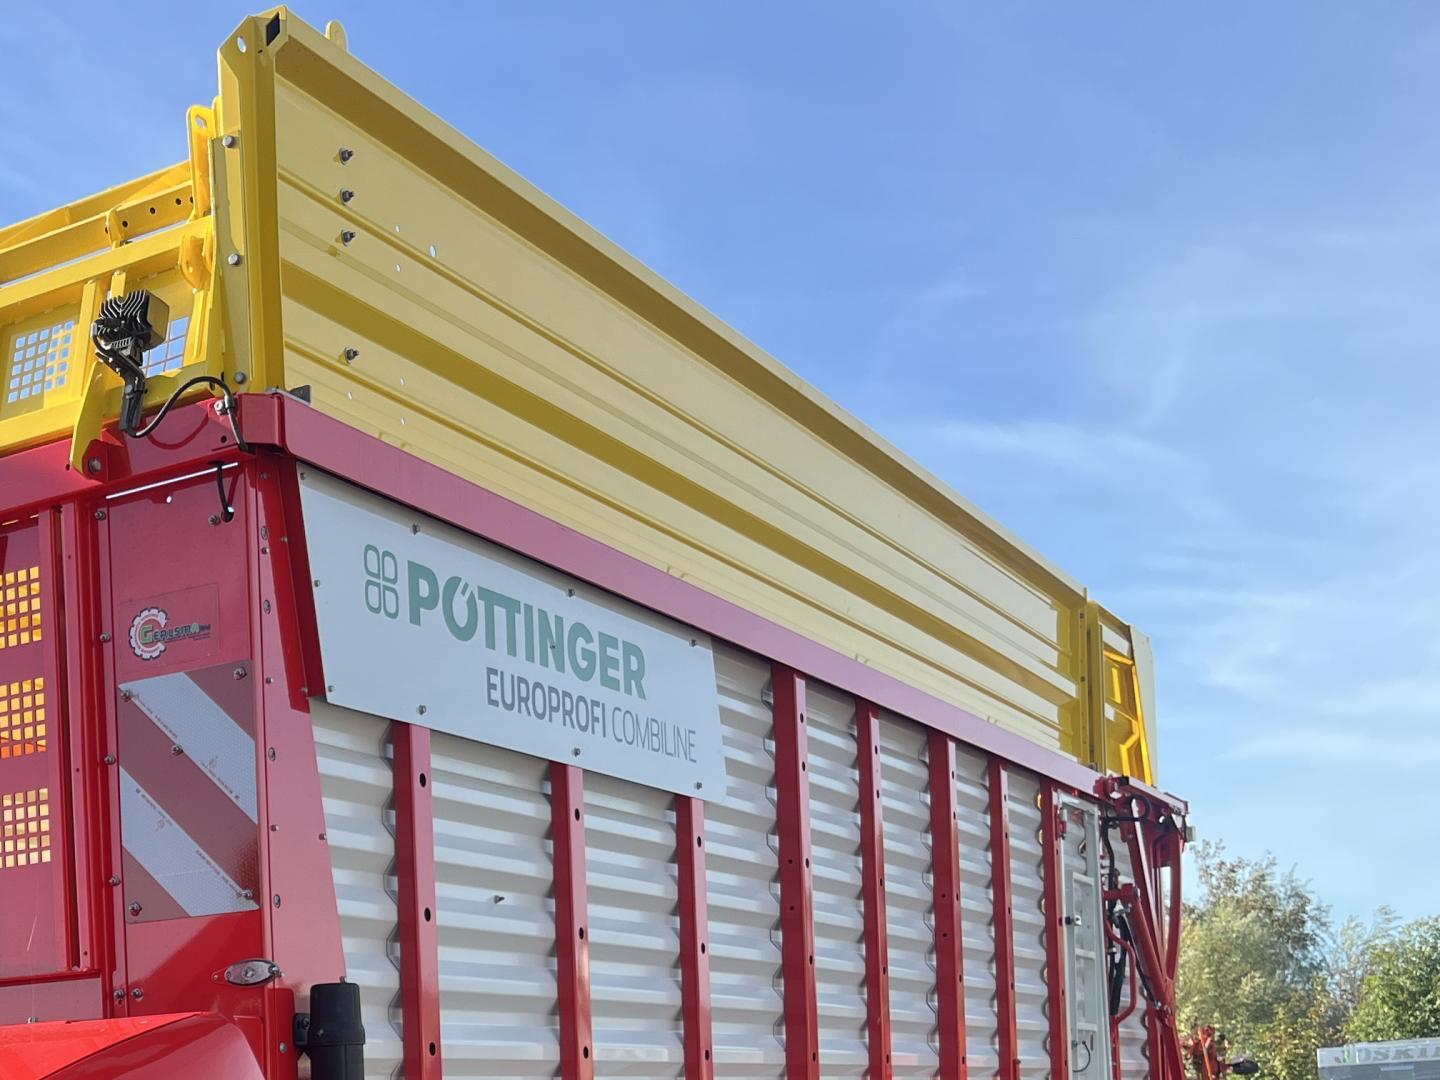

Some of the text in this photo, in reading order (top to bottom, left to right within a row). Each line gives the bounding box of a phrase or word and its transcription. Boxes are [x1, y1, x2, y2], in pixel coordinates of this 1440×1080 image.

[407, 559, 646, 700] PÖTTINGER
[486, 666, 698, 763] EUROPROFI COMBILINE
[1334, 1044, 1440, 1063] JOSKI
